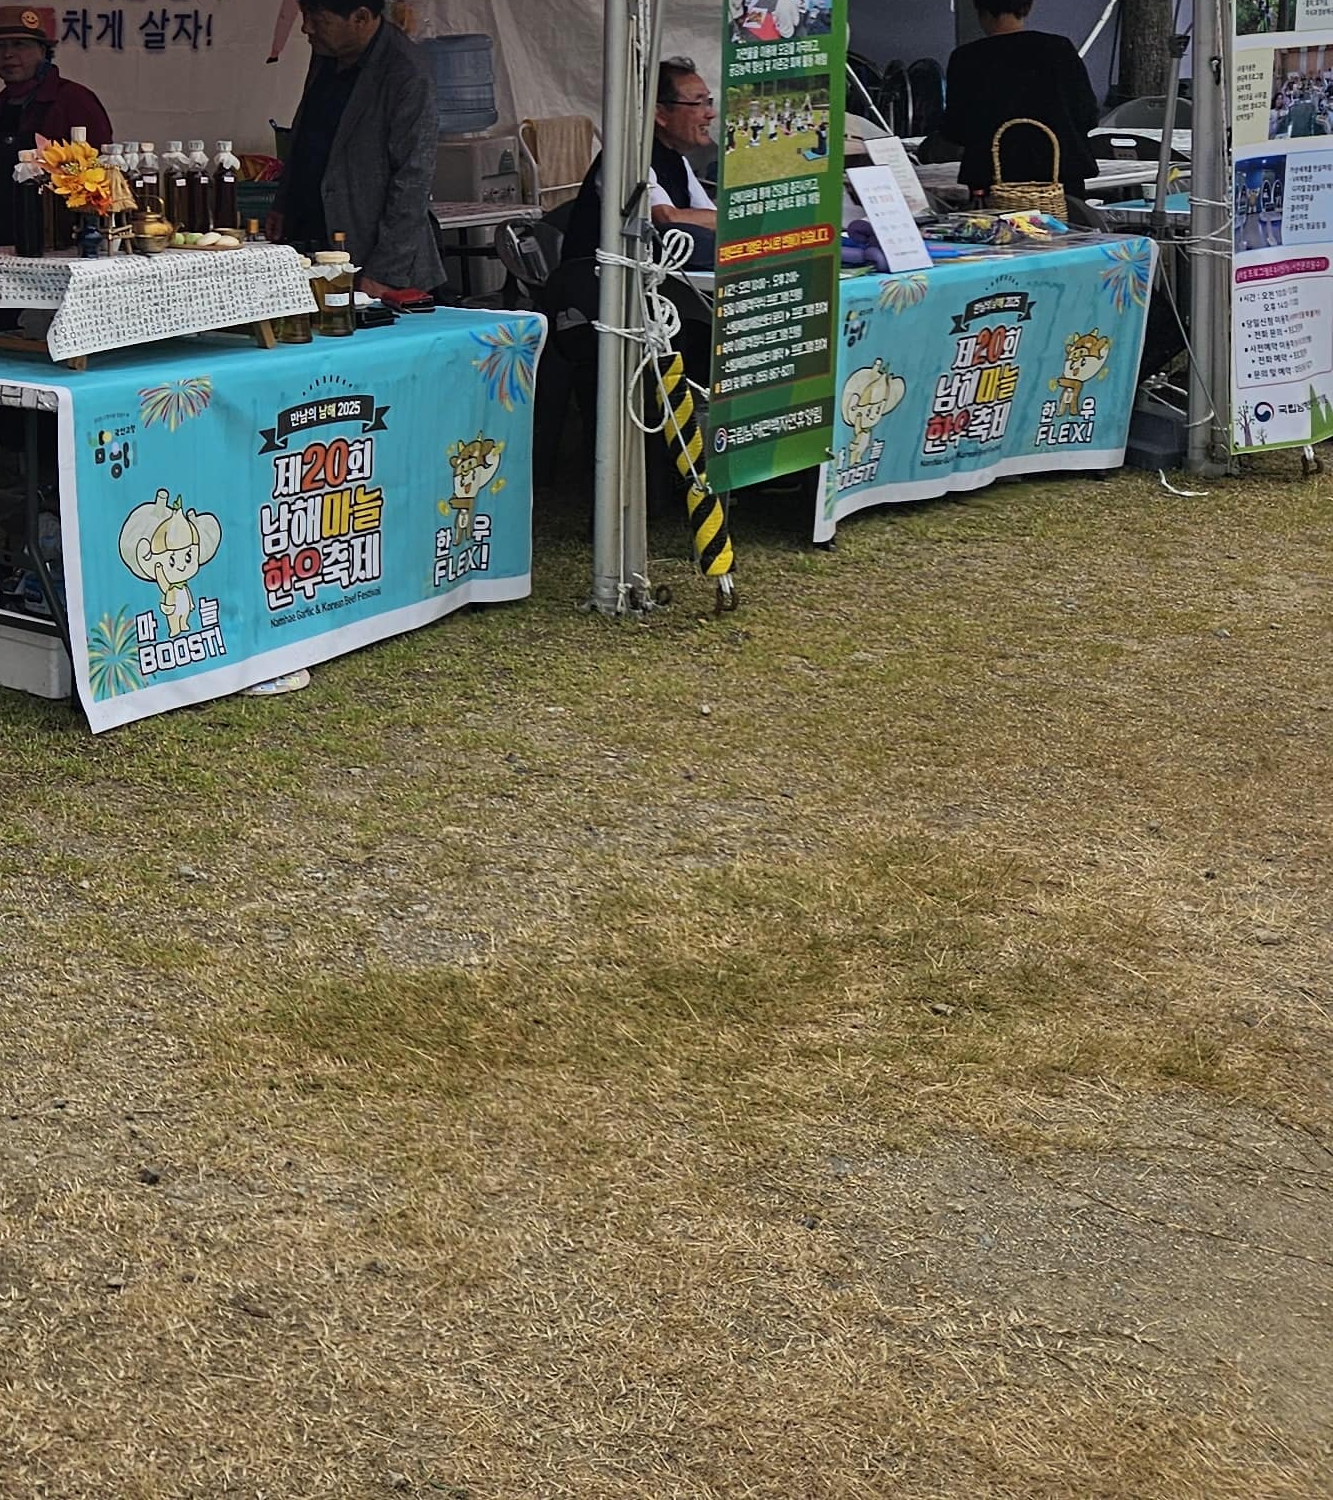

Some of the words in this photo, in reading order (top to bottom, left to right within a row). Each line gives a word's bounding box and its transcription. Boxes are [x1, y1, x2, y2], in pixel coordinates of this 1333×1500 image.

[138, 8, 213, 50] 살자!
[953, 326, 1023, 368] 제20회
[934, 363, 1019, 413] 남해마늘
[1041, 401, 1056, 424] 한
[1080, 397, 1097, 420] 우
[290, 408, 317, 428] 만남의
[319, 404, 336, 422] 남해
[337, 400, 361, 418] 2025
[924, 402, 1011, 454] 한우축제
[1034, 422, 1093, 447] FLEX!
[272, 438, 373, 498] 제20회
[260, 486, 384, 556] 남해마늘
[436, 527, 452, 558] 한
[472, 513, 491, 541] 우
[263, 536, 382, 611] 한우축제
[434, 545, 490, 588] FLEX!
[136, 613, 159, 644] 마
[199, 597, 220, 628] 늘
[270, 613, 294, 630] Namhae
[295, 610, 315, 626] Garlic
[322, 600, 345, 618] Korean
[345, 594, 358, 611] Beef
[357, 587, 382, 606] Festival
[138, 628, 226, 675] BOOST!
